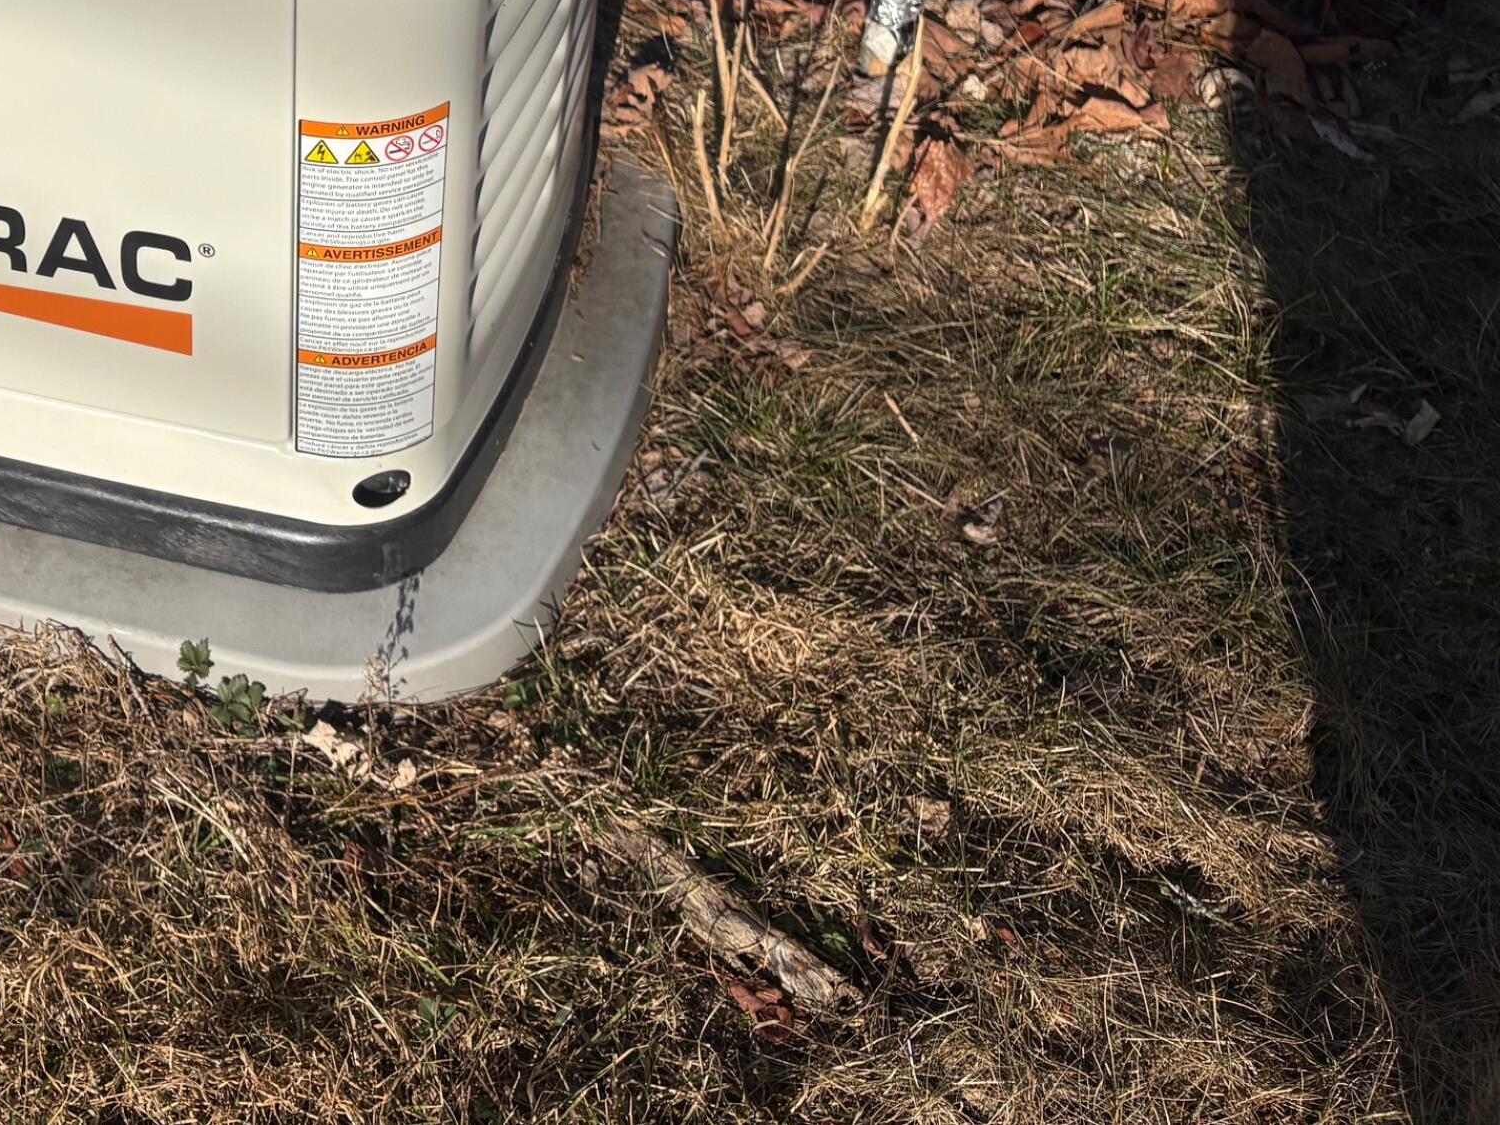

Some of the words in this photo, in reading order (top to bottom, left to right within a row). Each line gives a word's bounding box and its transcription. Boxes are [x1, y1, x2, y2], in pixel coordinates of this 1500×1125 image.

[356, 115, 425, 136] WARNING
[323, 232, 437, 259] AVERTISSEMENT
[332, 342, 426, 365] ADVERTENCIA
